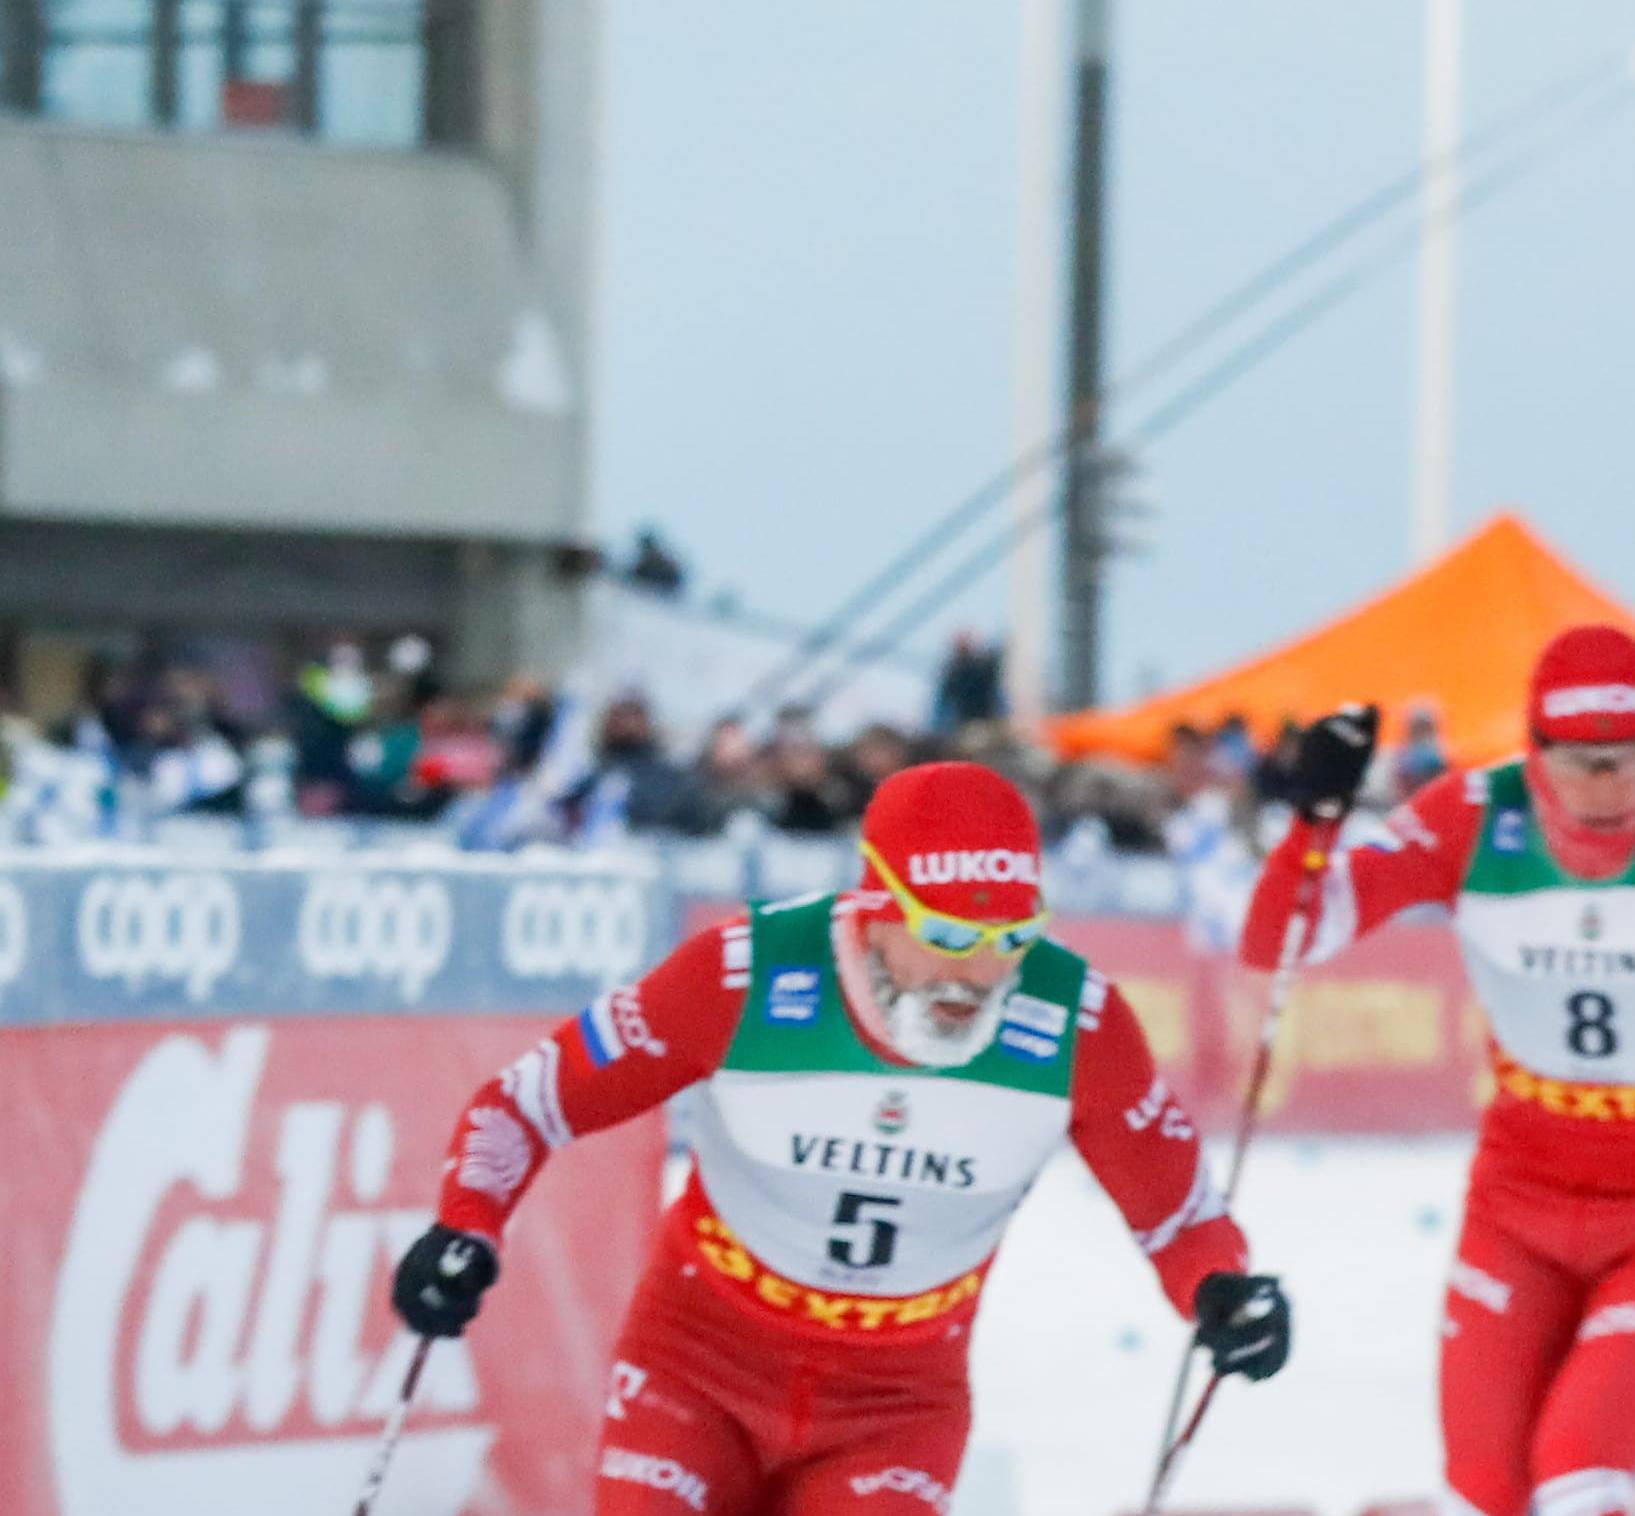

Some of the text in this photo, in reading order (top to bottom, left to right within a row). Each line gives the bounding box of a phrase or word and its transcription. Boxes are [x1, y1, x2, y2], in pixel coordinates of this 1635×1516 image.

[76, 870, 242, 1002] coop
[299, 870, 452, 1001] coop
[1565, 988, 1618, 1060] 8
[792, 1132, 977, 1188] VELTINS
[827, 1191, 903, 1270] 5
